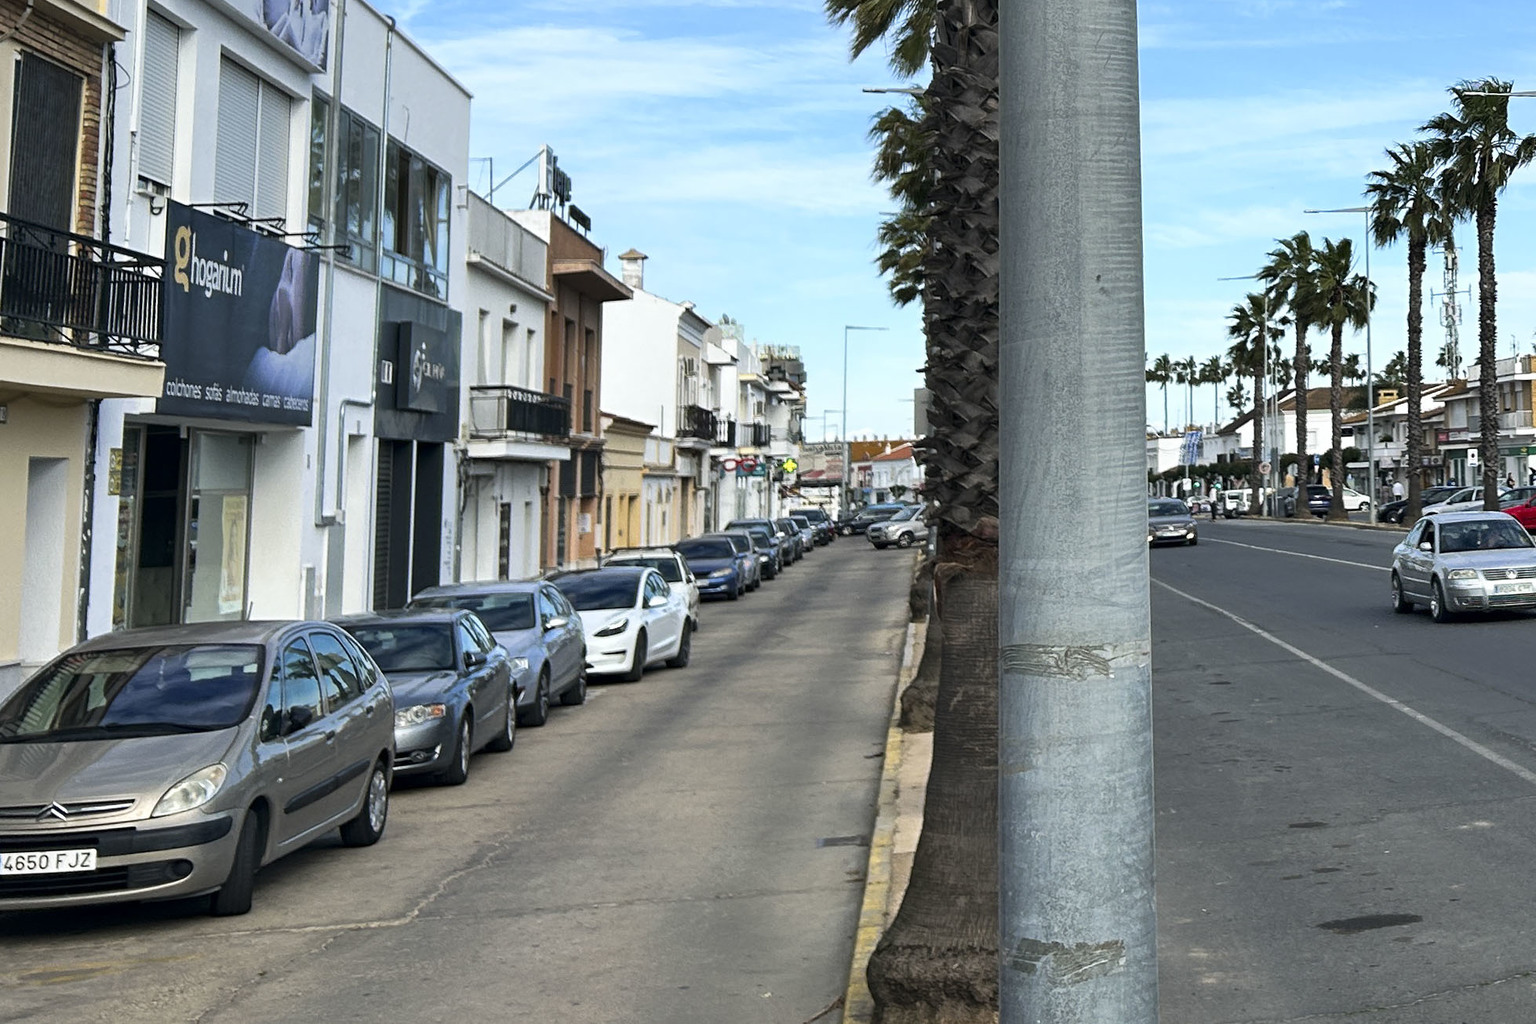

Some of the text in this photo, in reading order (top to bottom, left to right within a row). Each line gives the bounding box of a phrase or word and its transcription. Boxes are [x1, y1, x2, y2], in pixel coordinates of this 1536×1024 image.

[190, 231, 243, 299] hogarium
[166, 377, 202, 401] colchones
[205, 382, 223, 403] sofás
[226, 385, 260, 406] almohadas
[4, 852, 92, 871] 4650 FJZ
